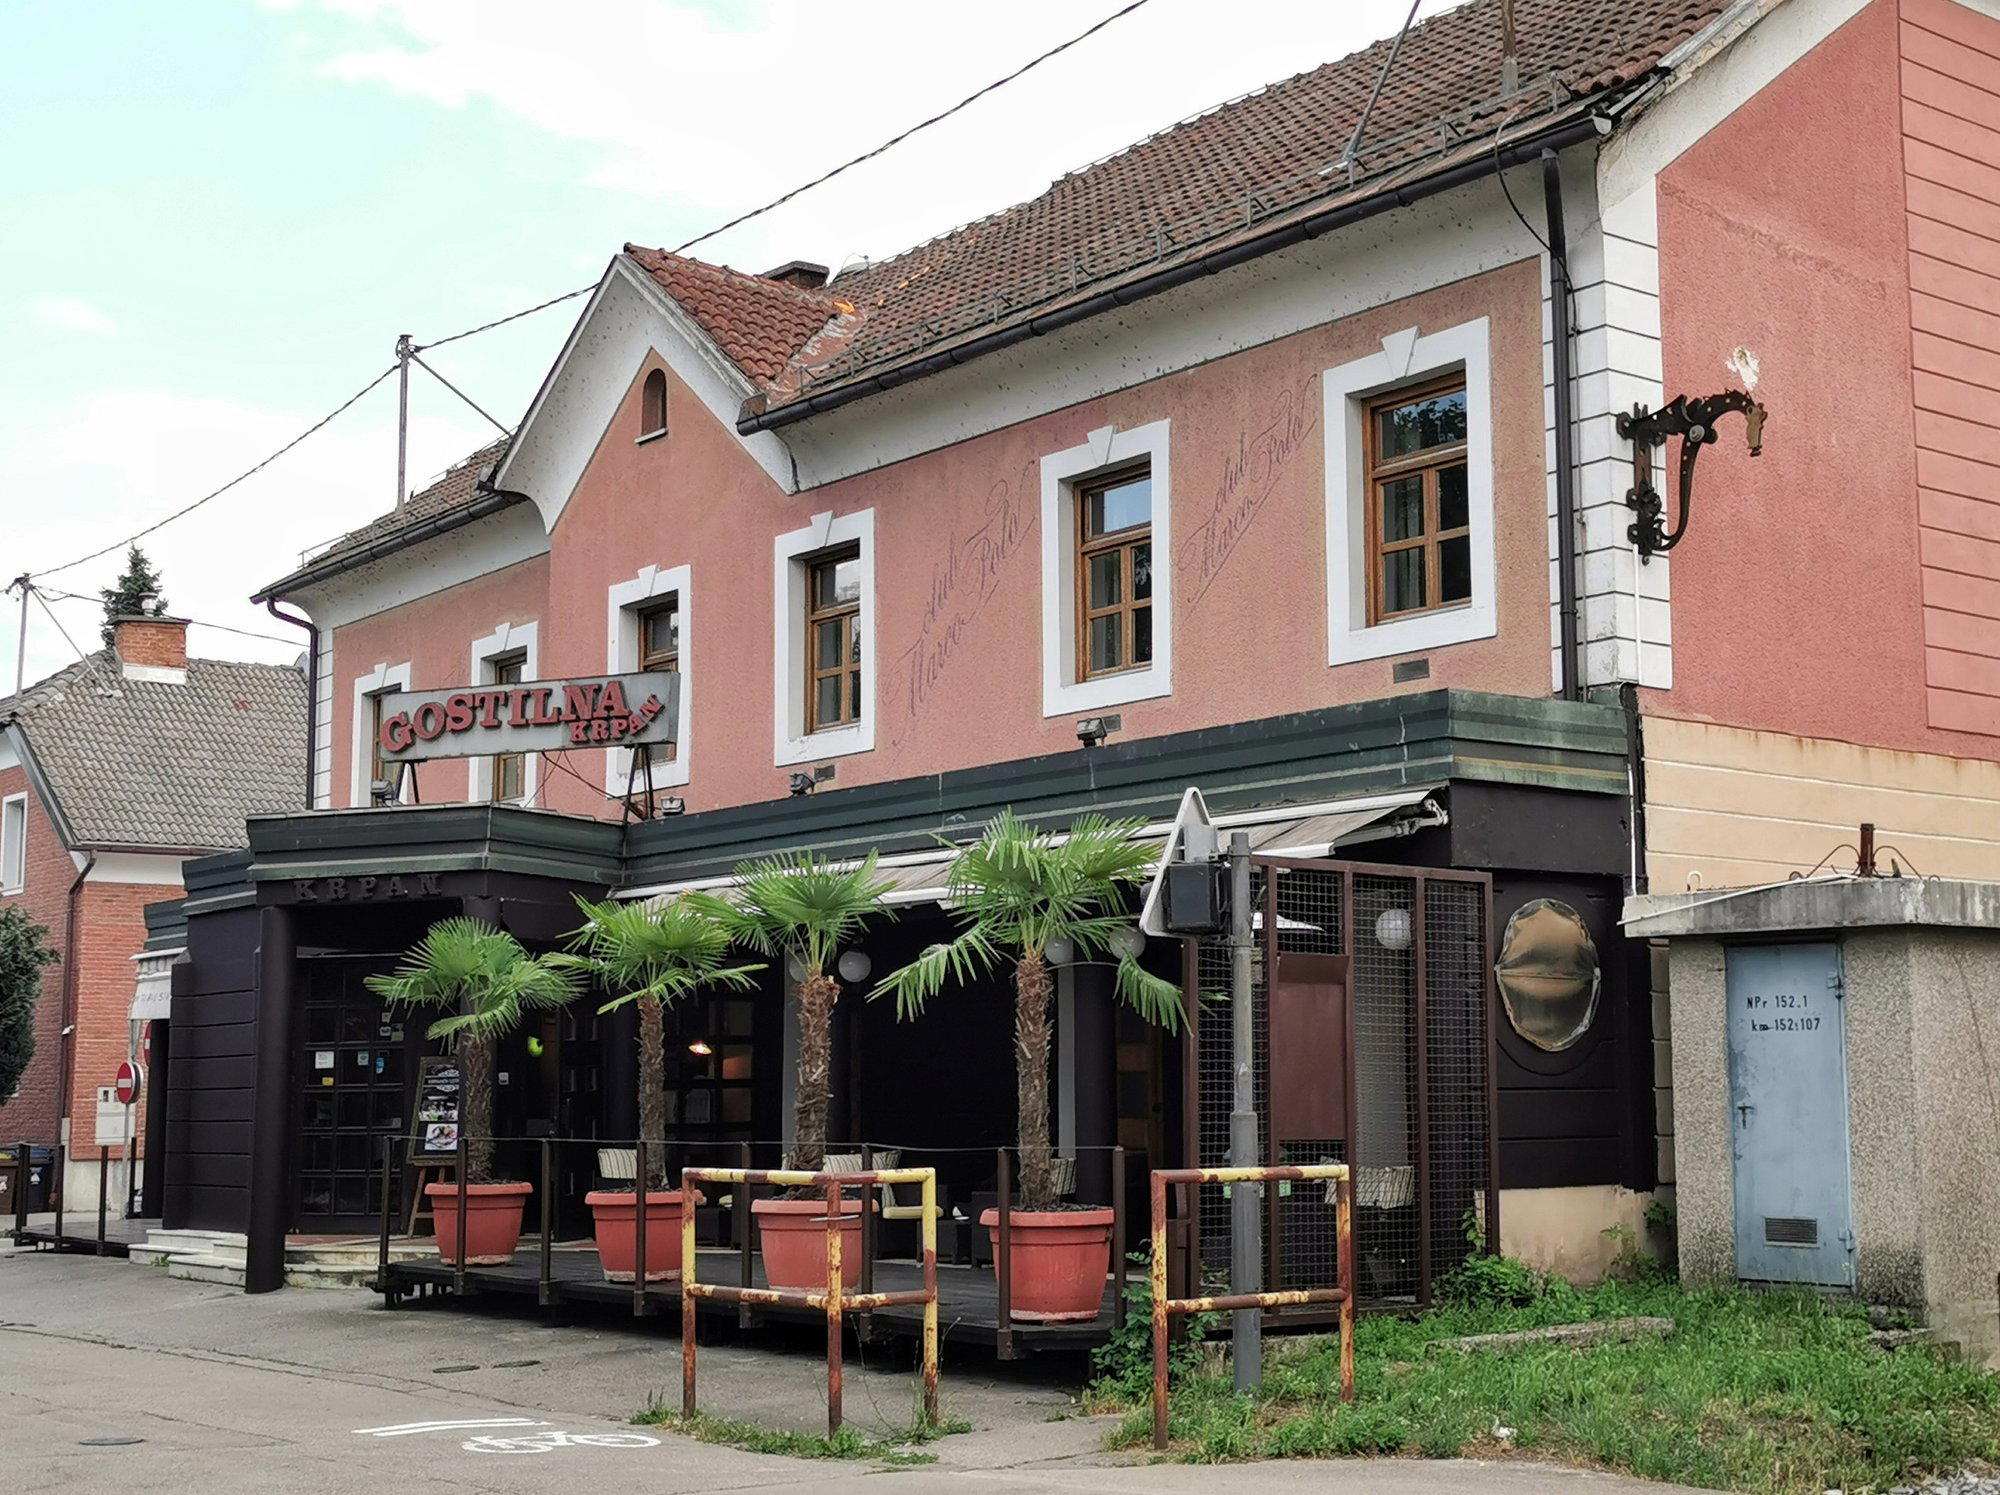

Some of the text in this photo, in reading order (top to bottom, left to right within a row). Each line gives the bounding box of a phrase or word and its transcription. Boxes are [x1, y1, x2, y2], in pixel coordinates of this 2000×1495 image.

[380, 680, 634, 753] GOSTILNA
[569, 693, 666, 745] KRPAN
[292, 873, 443, 901] KRPAN
[1746, 995, 1768, 1010] NPr
